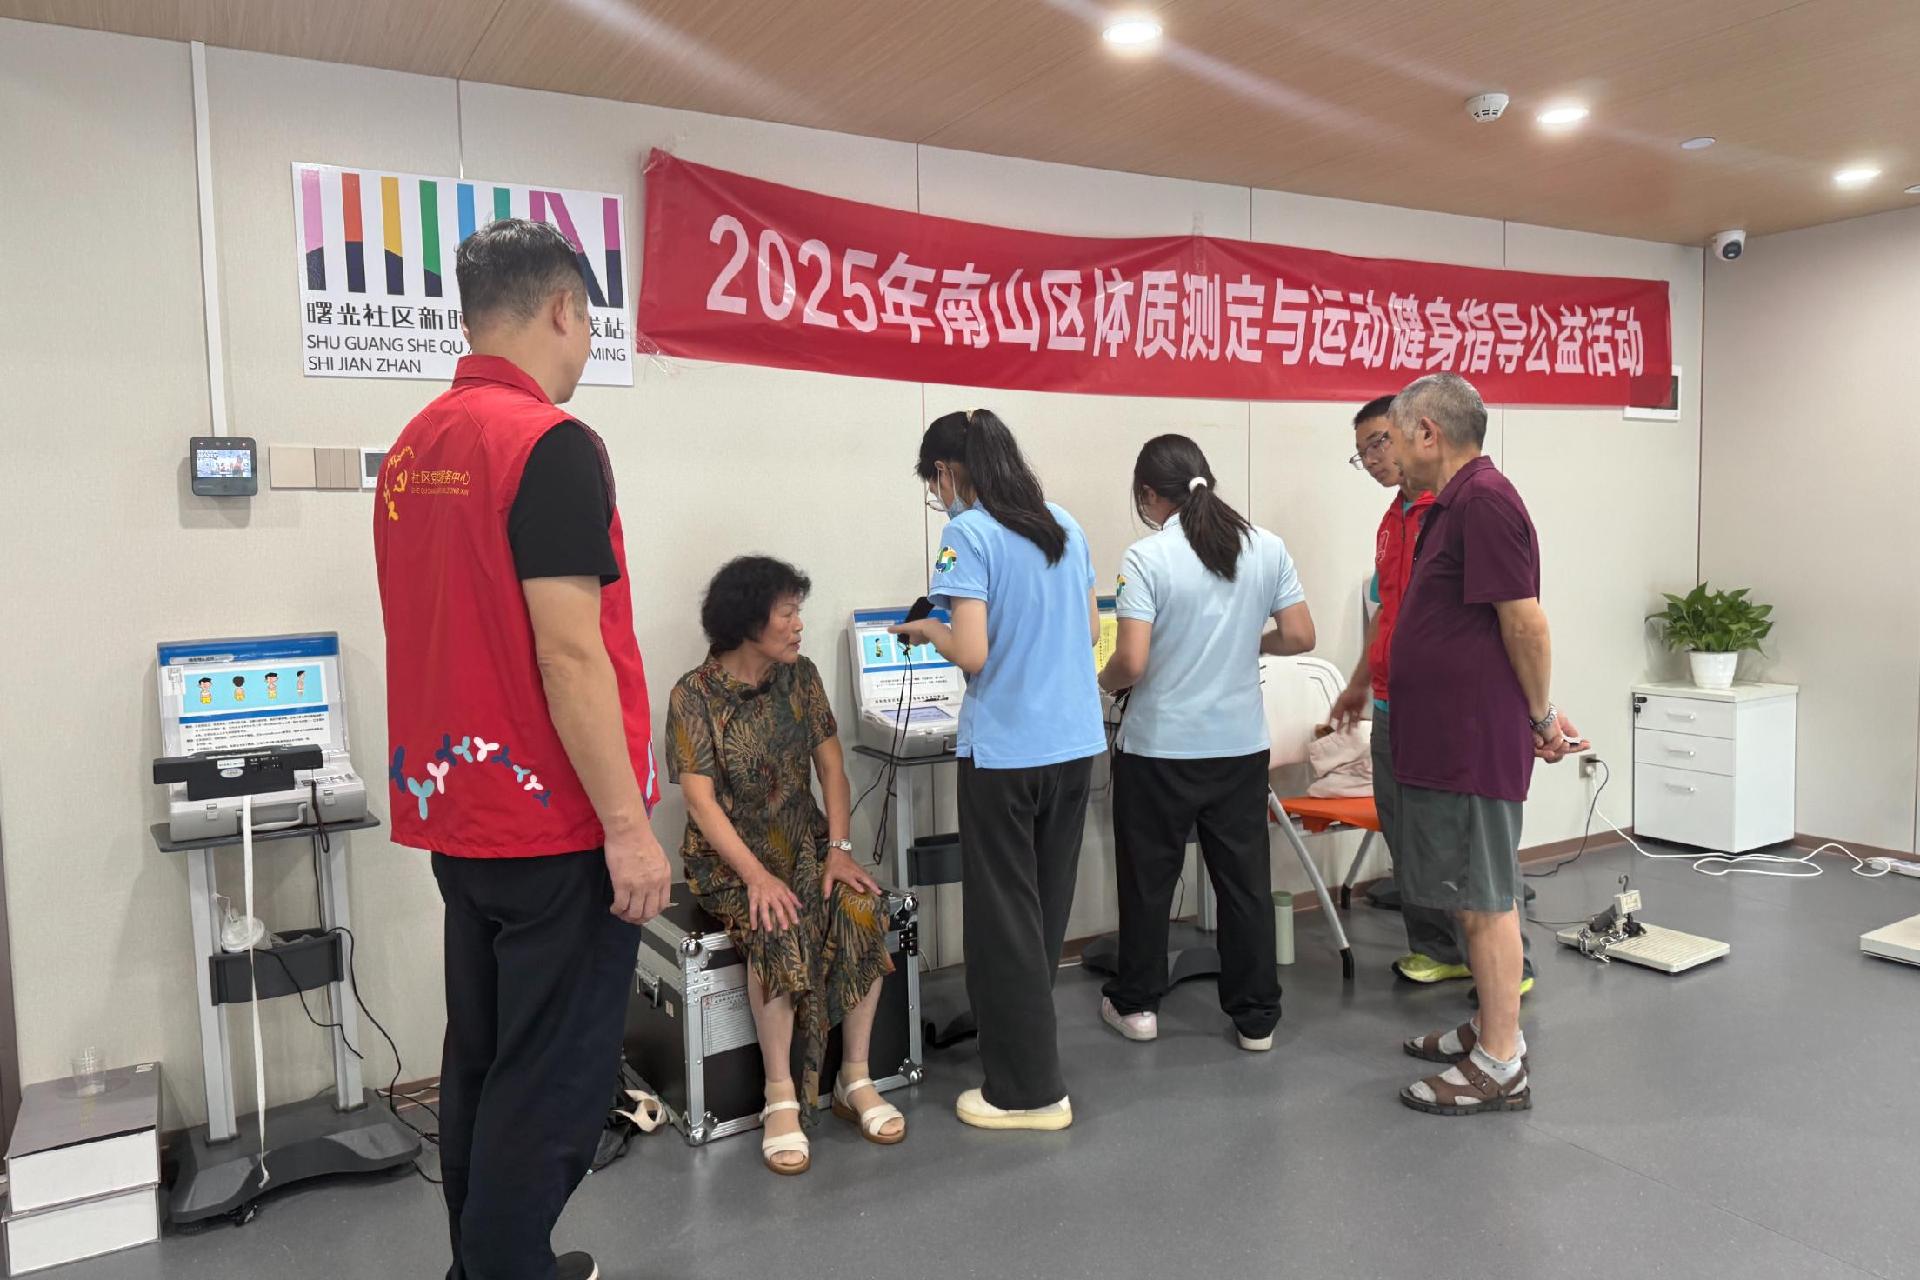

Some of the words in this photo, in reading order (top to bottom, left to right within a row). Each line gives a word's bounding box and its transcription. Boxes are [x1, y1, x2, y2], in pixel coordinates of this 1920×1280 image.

[706, 214, 1645, 378] 2025年南山区体质测定与运动健身指导公益活动
[307, 335, 340, 349] SHU
[345, 336, 404, 351] GUANG
[407, 338, 437, 353] SHE
[440, 340, 464, 355] QU
[308, 356, 334, 371] SHI
[338, 357, 372, 372] JIAN
[376, 358, 421, 373] ZHAN
